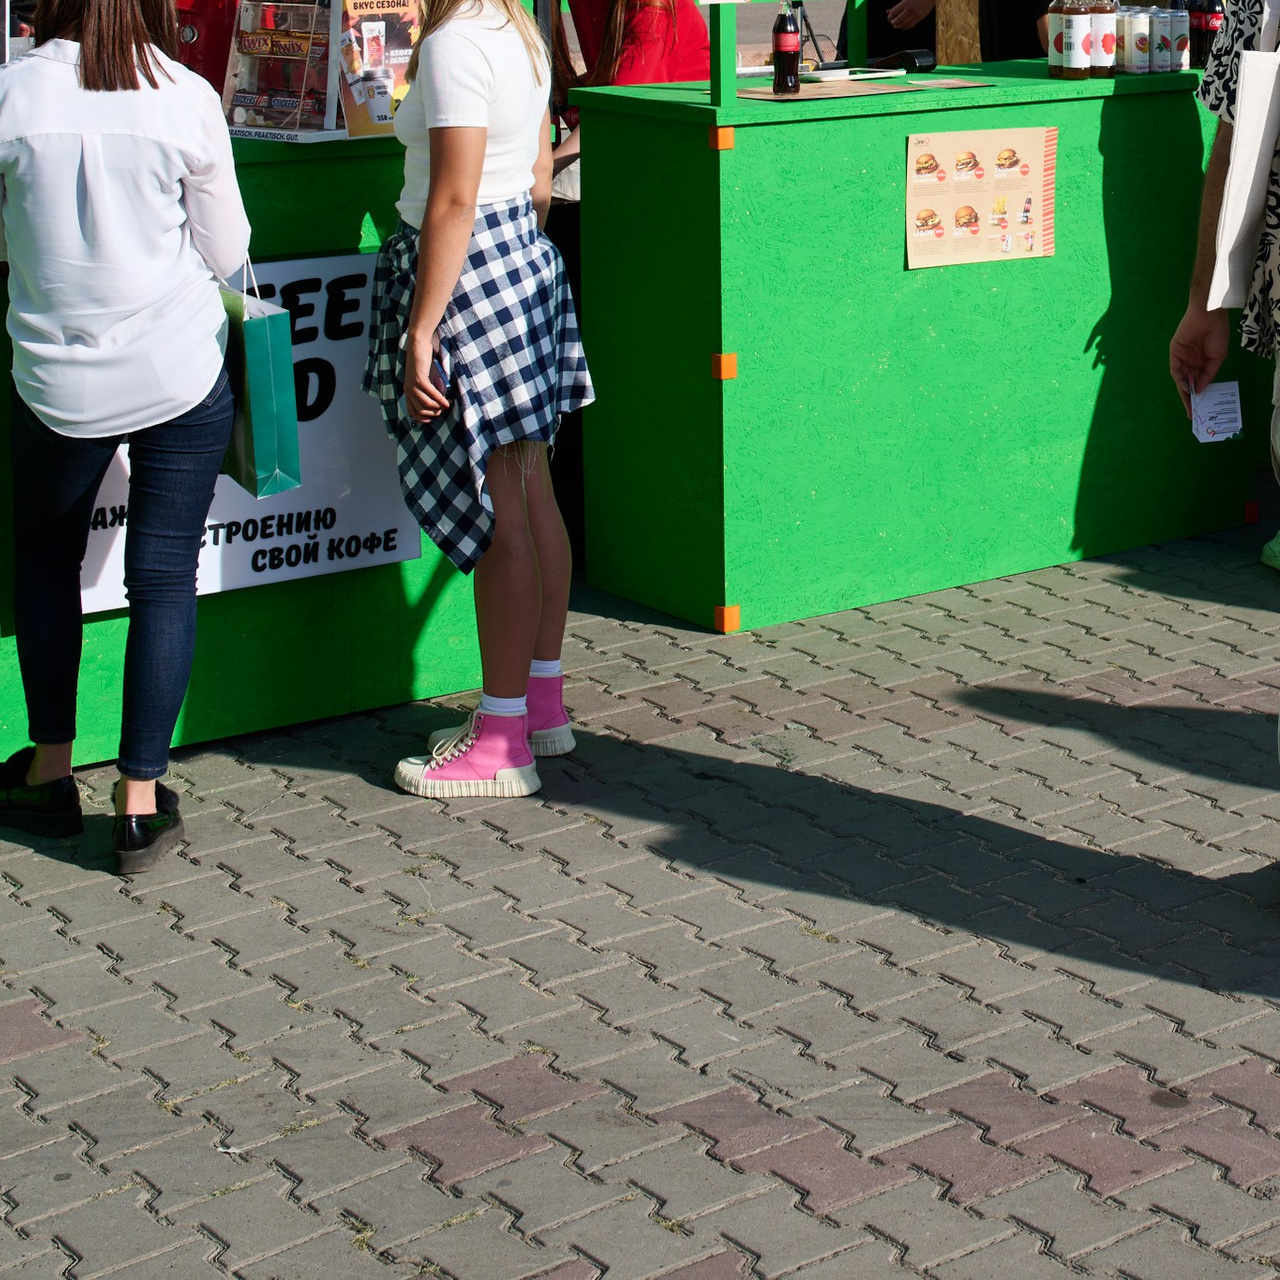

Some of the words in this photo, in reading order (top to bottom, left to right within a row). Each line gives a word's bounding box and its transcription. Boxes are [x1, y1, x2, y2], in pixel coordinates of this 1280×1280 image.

[353, 1, 375, 10] ВКУС
[375, 0, 410, 9] СЕЗОНА!
[234, 94, 257, 105] NICKERS
[229, 129, 254, 137] RATISCH.
[199, 507, 336, 549] ТРОЕНИЮ
[251, 533, 320, 572] СВОЙ
[327, 528, 399, 561] КОФЕ
